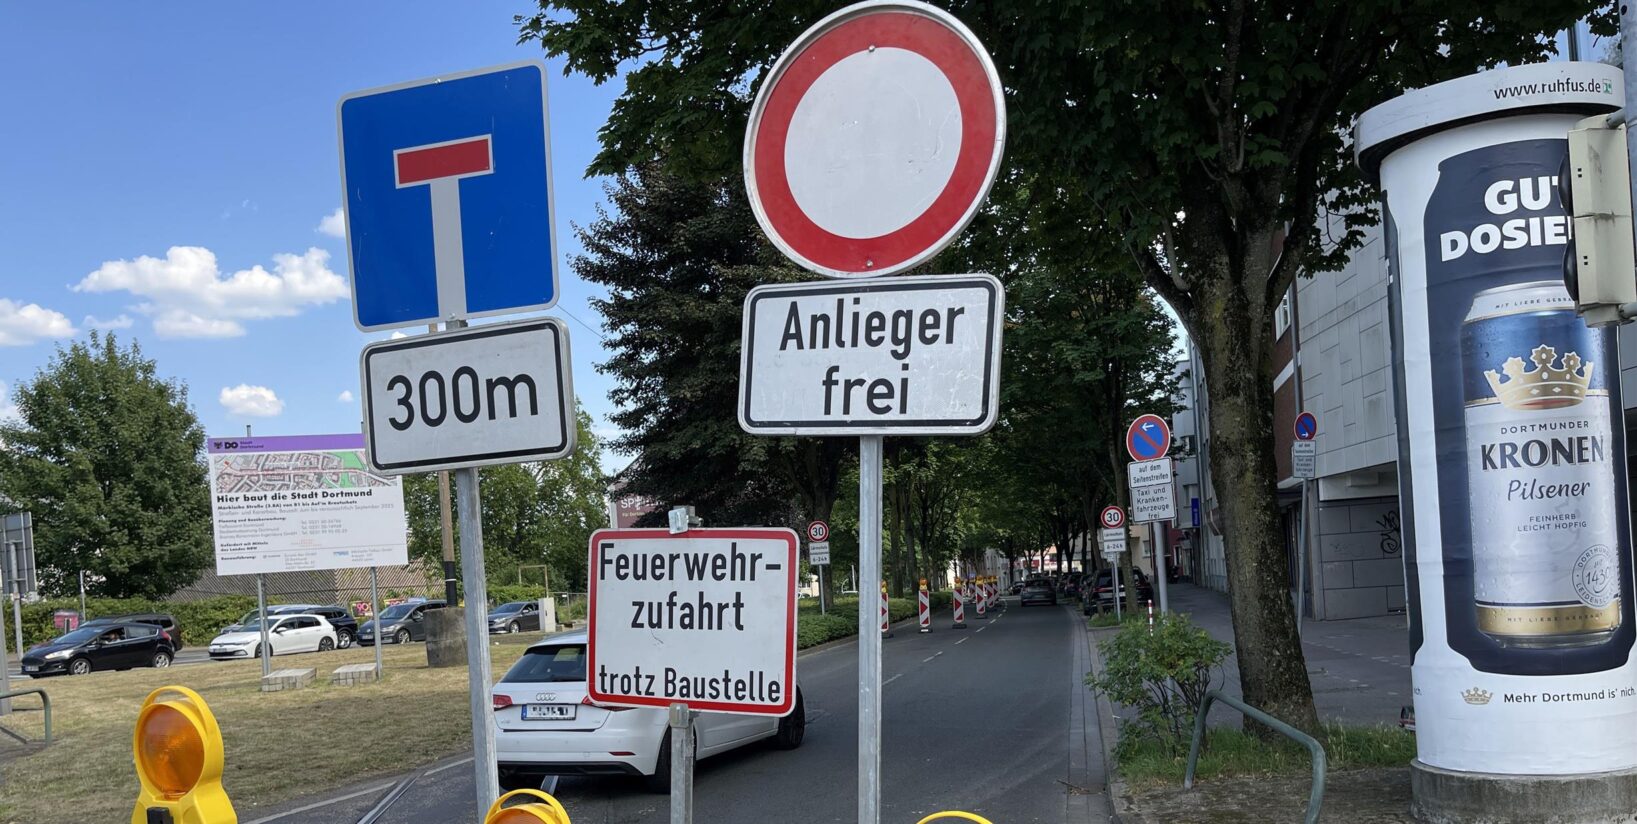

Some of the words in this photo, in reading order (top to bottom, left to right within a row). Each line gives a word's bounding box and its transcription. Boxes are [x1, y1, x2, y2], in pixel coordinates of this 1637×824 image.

[1494, 78, 1601, 99] www.ruhfus.de
[1440, 216, 1573, 262] DOSIE
[779, 297, 965, 360] Anlieger
[822, 363, 909, 415] frei
[387, 365, 538, 431] 300m
[1501, 420, 1589, 435] DORTMUNDER
[224, 441, 239, 449] DO
[1481, 435, 1605, 471] KRONEN
[1139, 465, 1148, 473] auf
[1133, 473, 1169, 484] Seitenstreifen
[217, 495, 240, 503] Hier
[243, 494, 267, 502] baut
[291, 491, 318, 500] Stadt
[322, 489, 373, 498] Dortmund
[1507, 479, 1590, 501] Pilsener
[1136, 496, 1168, 504] Kranken-
[1136, 504, 1170, 513] fahrzeuge
[1106, 512, 1120, 522] 30
[1529, 513, 1576, 523] FEINHERB
[812, 527, 824, 537] 30
[1517, 523, 1551, 532] LEICHT
[1555, 520, 1587, 530] HOPFIG
[600, 542, 782, 581] Feuerwehr-
[631, 591, 745, 631] zufahrt
[599, 664, 656, 696] trotz
[664, 667, 781, 702] Baustelle
[1504, 692, 1537, 703] Mehr
[1542, 689, 1605, 702] Dortmund
[1620, 686, 1637, 697] nich.
